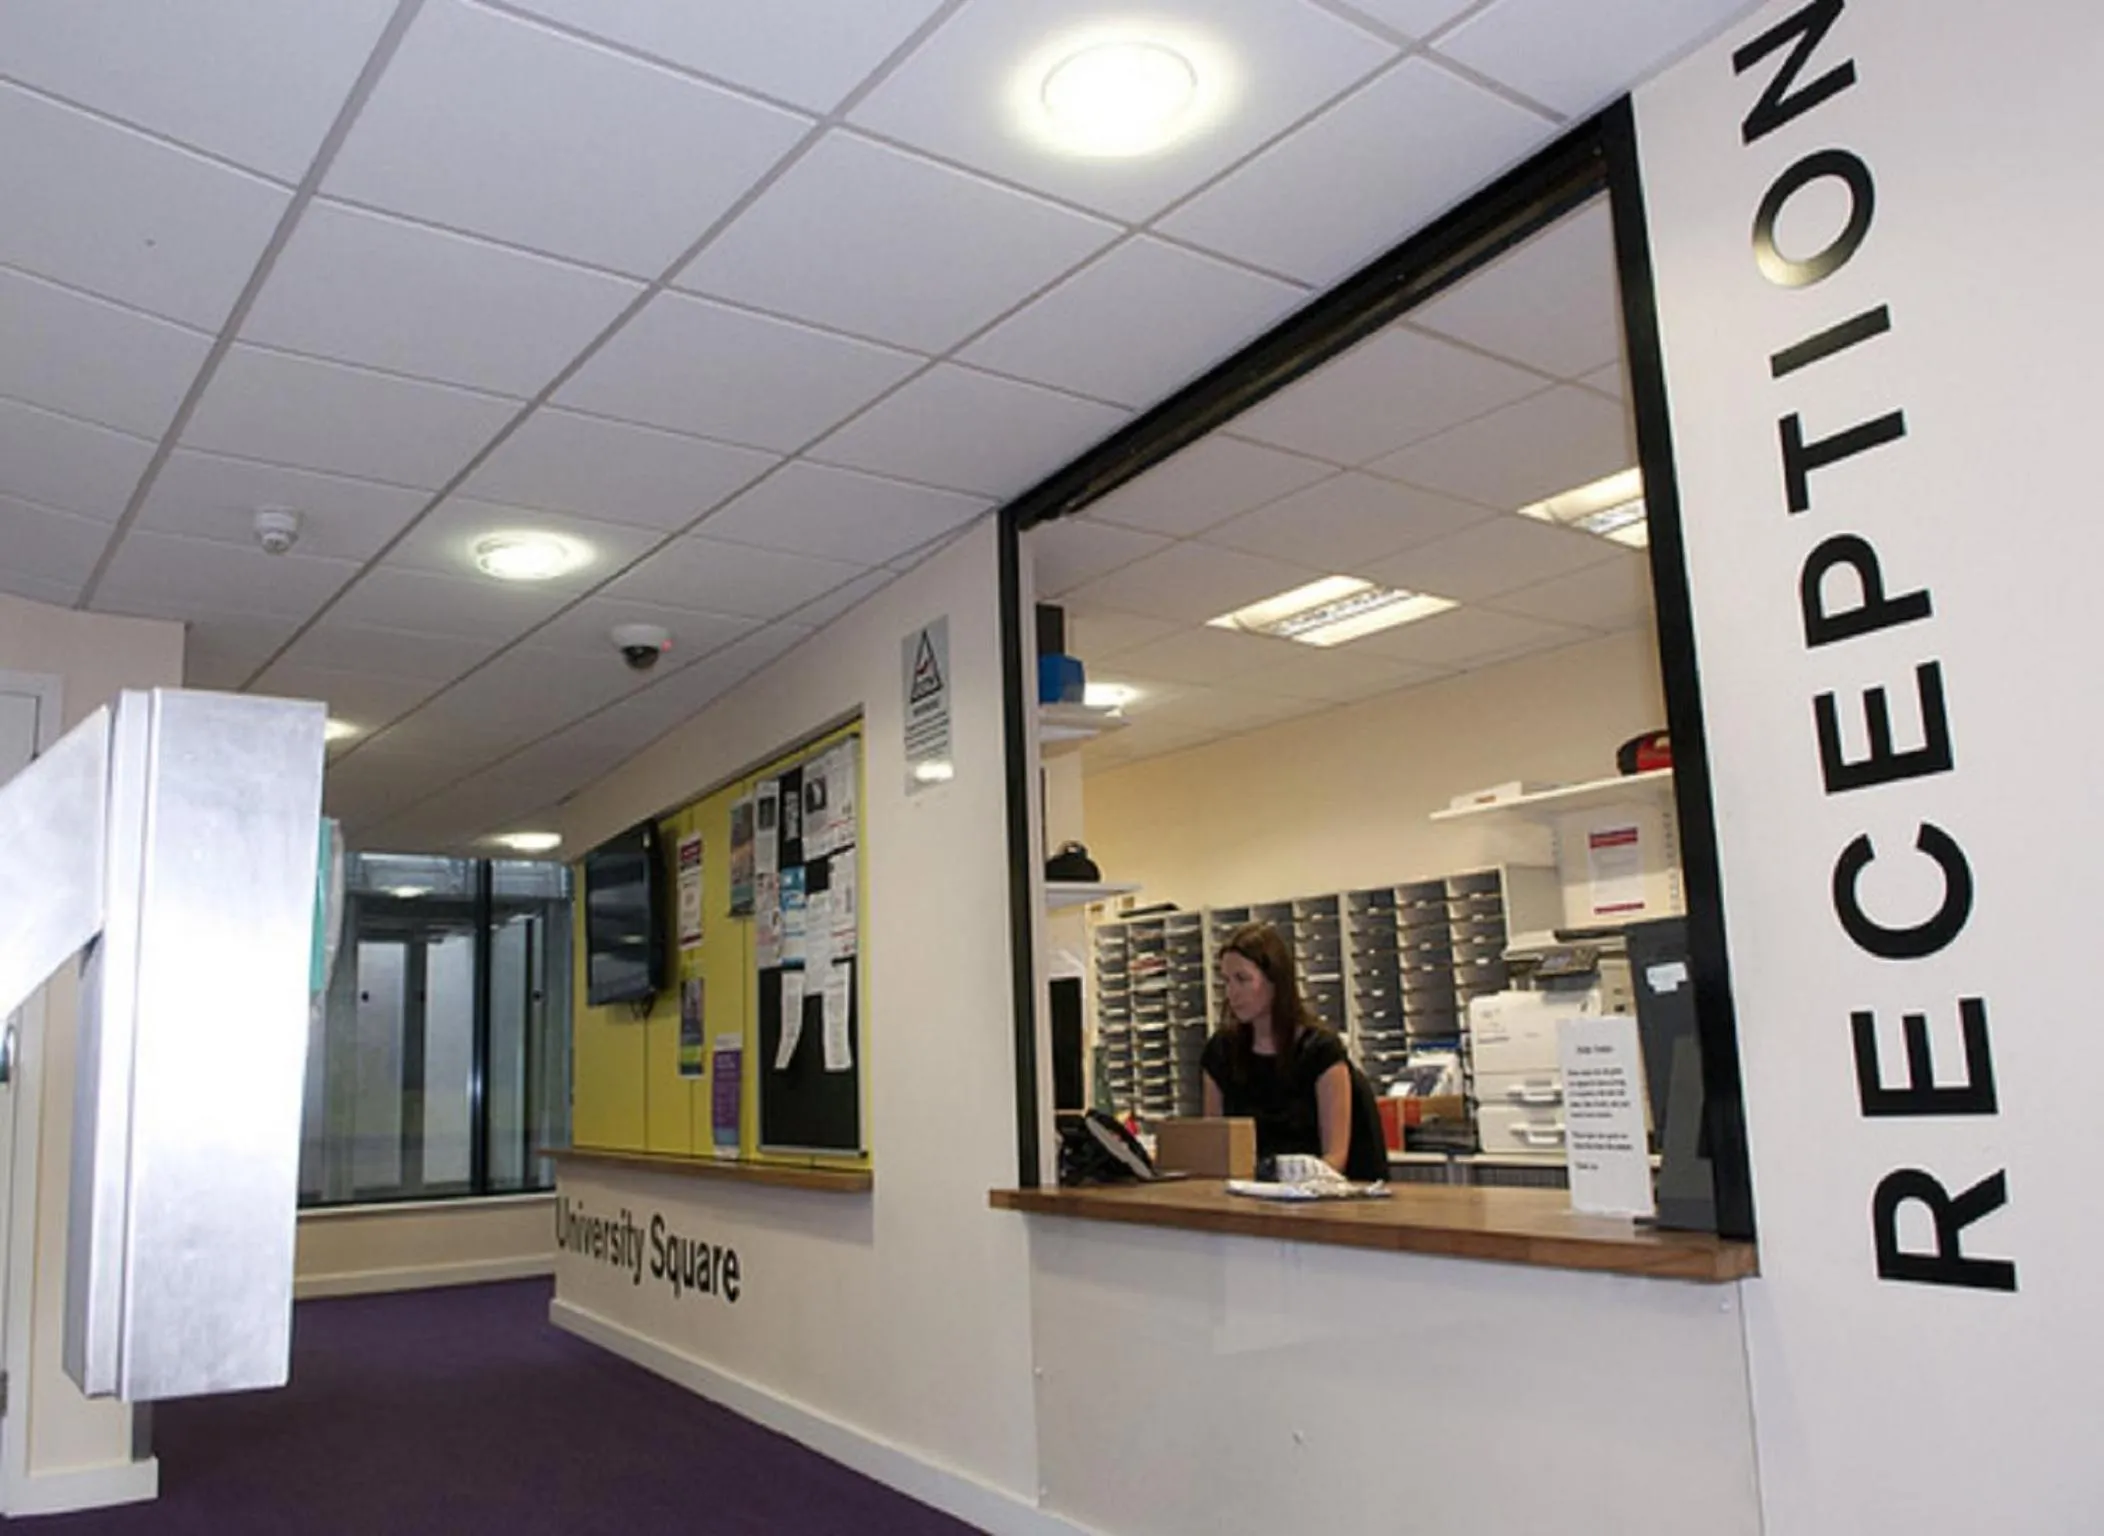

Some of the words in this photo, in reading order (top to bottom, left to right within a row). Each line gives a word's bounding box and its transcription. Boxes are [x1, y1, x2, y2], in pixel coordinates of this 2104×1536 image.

[1732, 0, 2018, 1292] RECEPTION
[555, 1197, 644, 1286] University
[651, 1213, 740, 1302] Square
